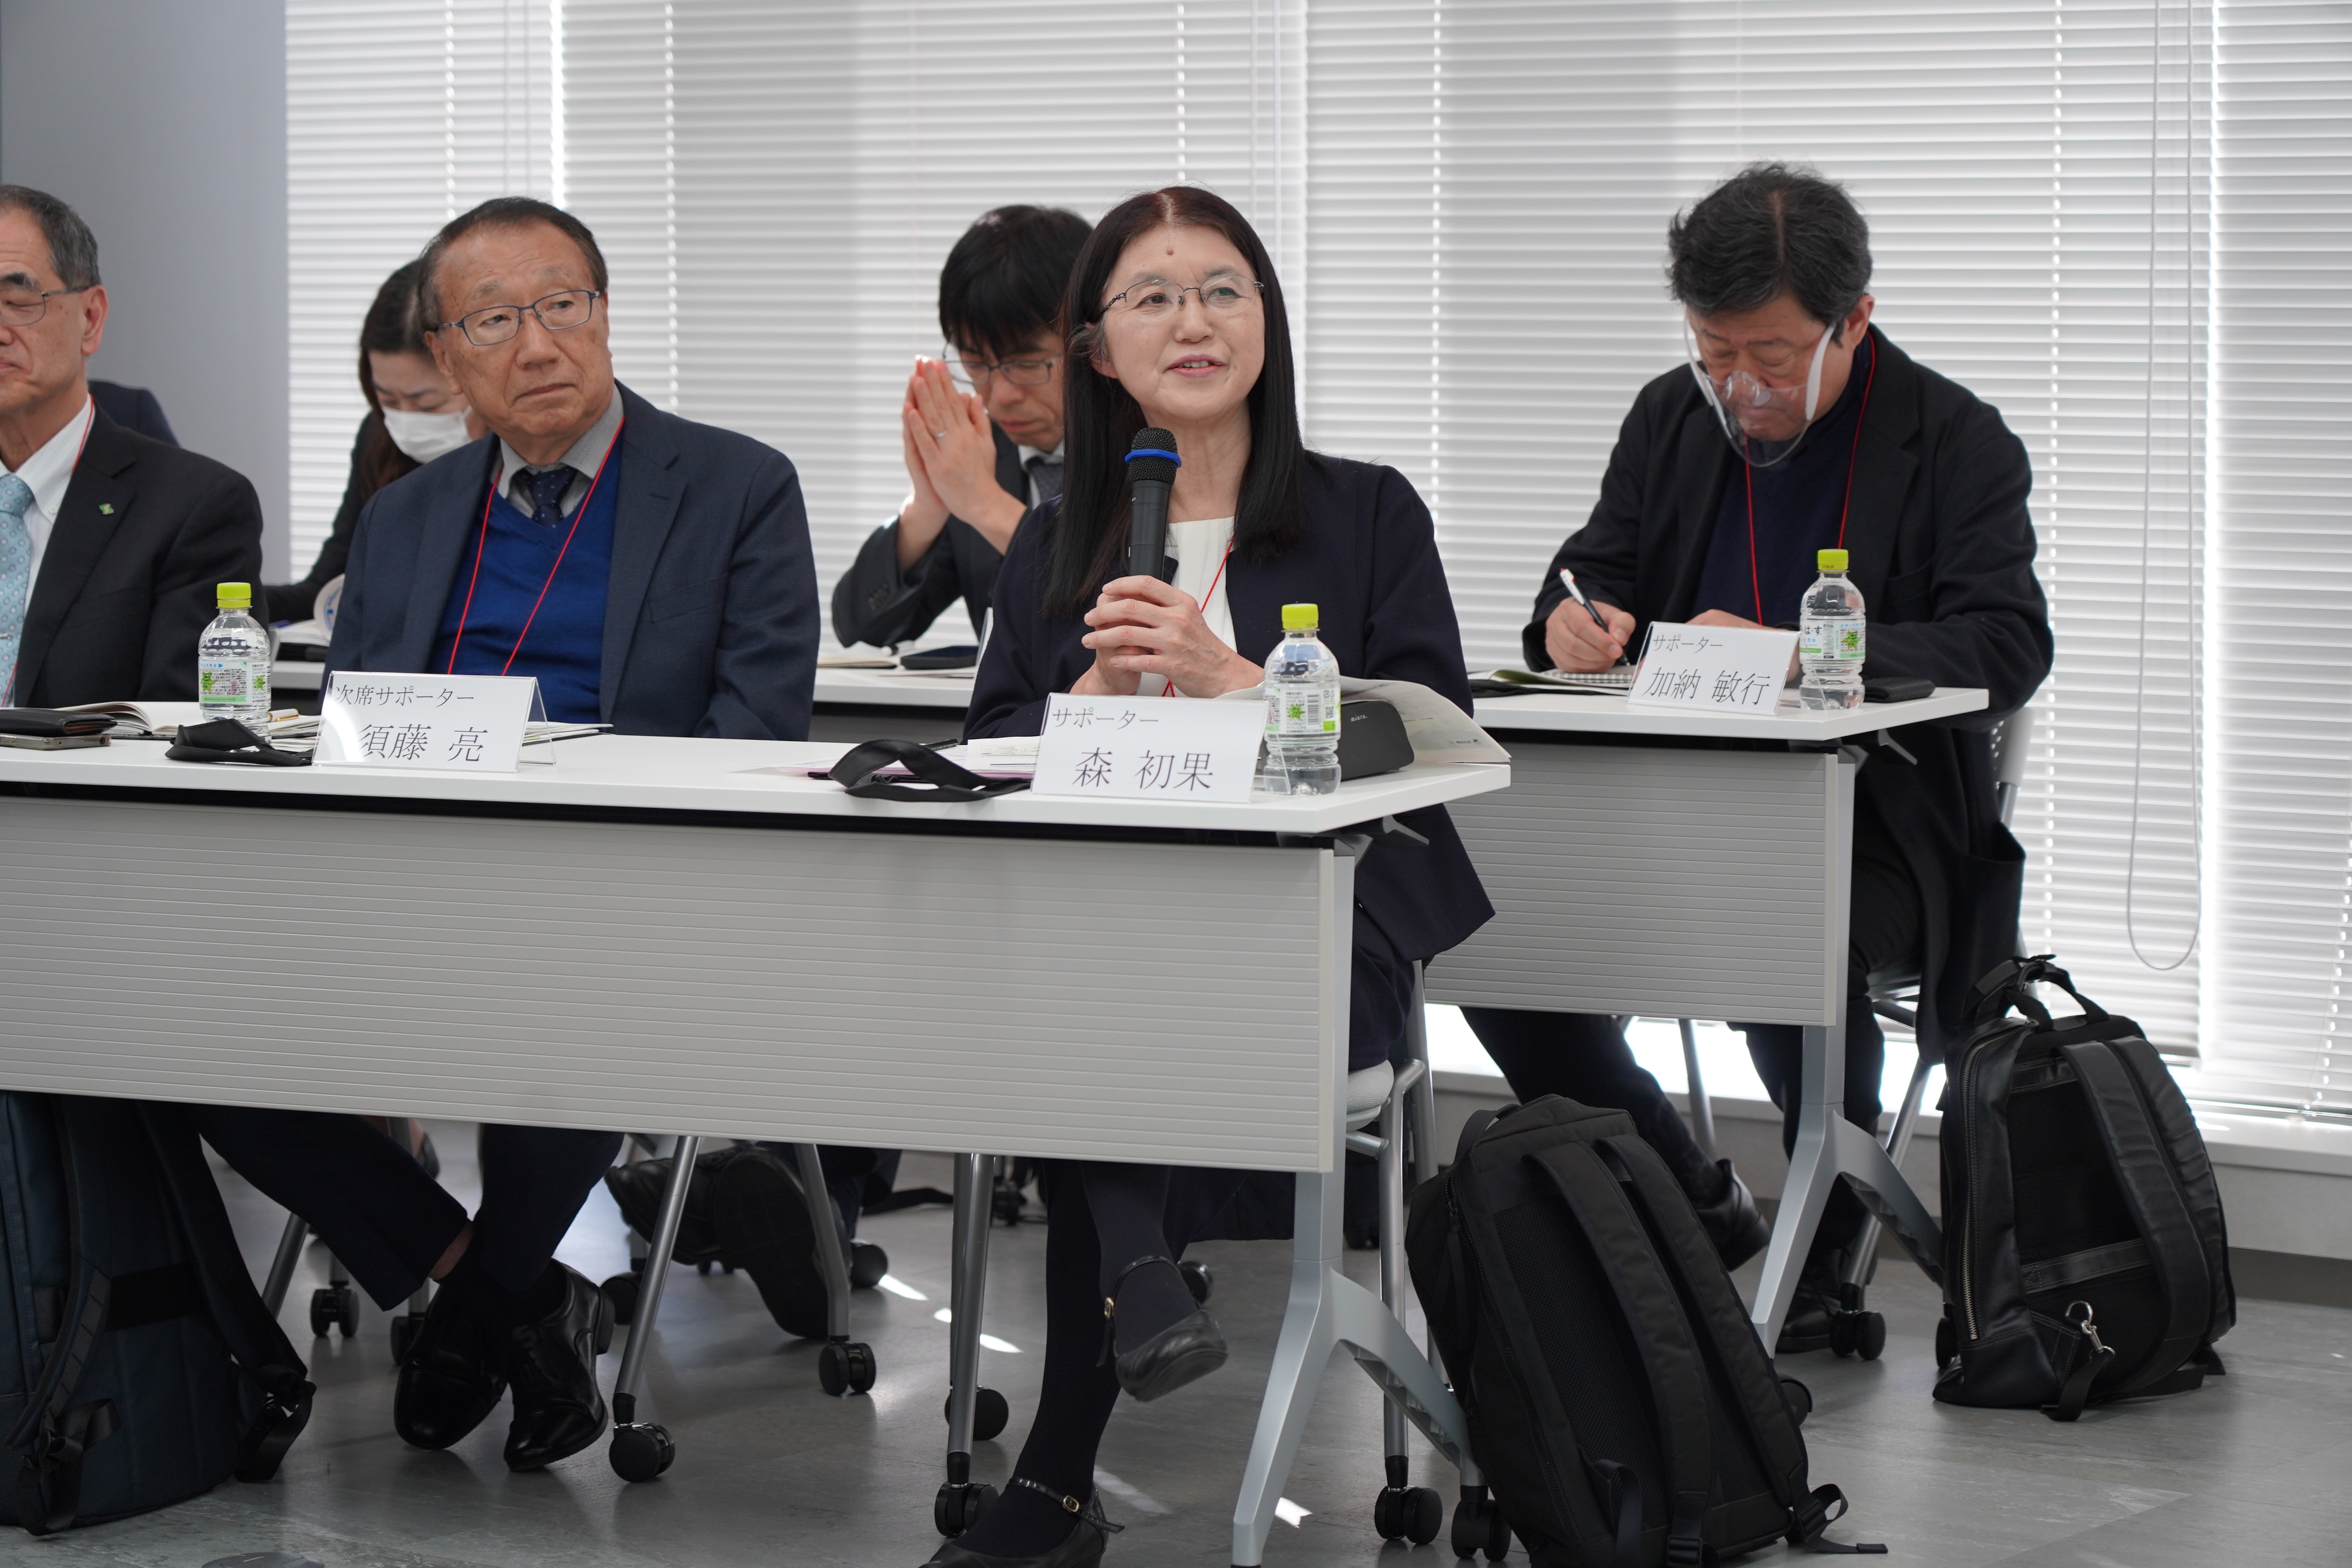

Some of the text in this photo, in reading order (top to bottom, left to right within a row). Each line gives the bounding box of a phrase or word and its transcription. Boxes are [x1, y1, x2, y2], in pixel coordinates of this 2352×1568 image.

[1653, 633, 1723, 654] サポーター
[334, 684, 474, 708] 次席サポーター
[1642, 667, 1771, 705] 加納 敏行
[1052, 706, 1159, 730] サポーター
[358, 723, 488, 761] 須藤 亮
[1071, 746, 1214, 791] 森 初果
